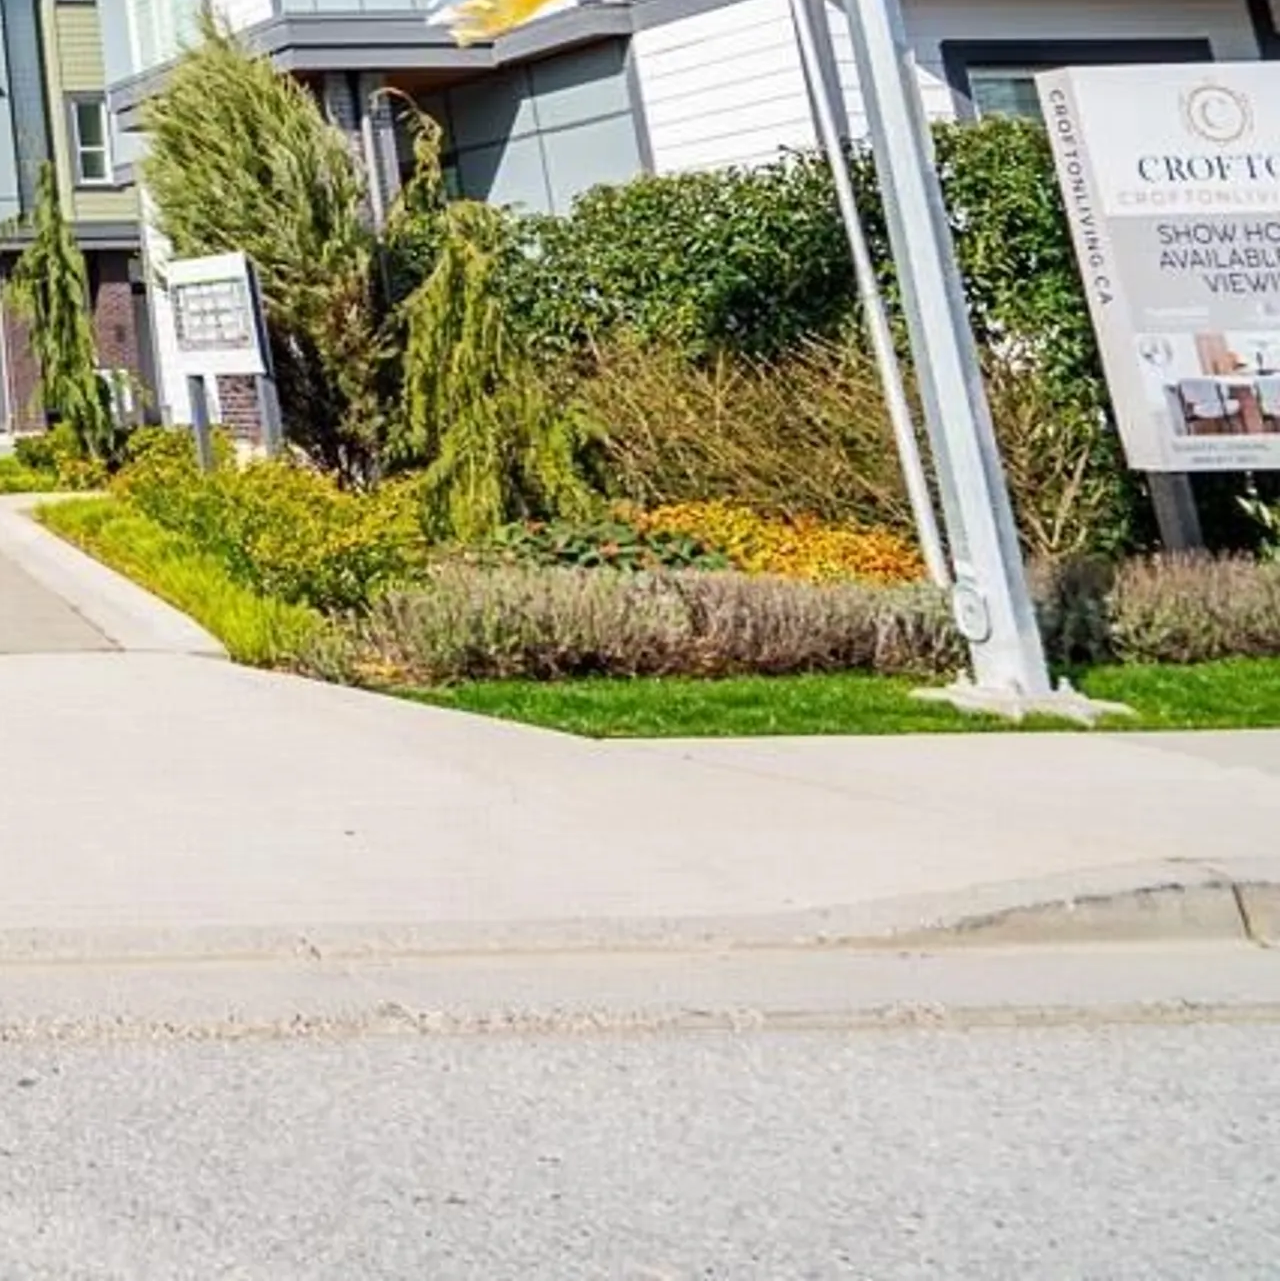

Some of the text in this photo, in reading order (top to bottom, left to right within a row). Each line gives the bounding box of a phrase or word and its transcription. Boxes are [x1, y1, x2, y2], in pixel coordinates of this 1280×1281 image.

[1157, 224, 1236, 244] SHOW
[1160, 248, 1280, 269] AVAILABL
[1203, 272, 1280, 294] VIEWI
